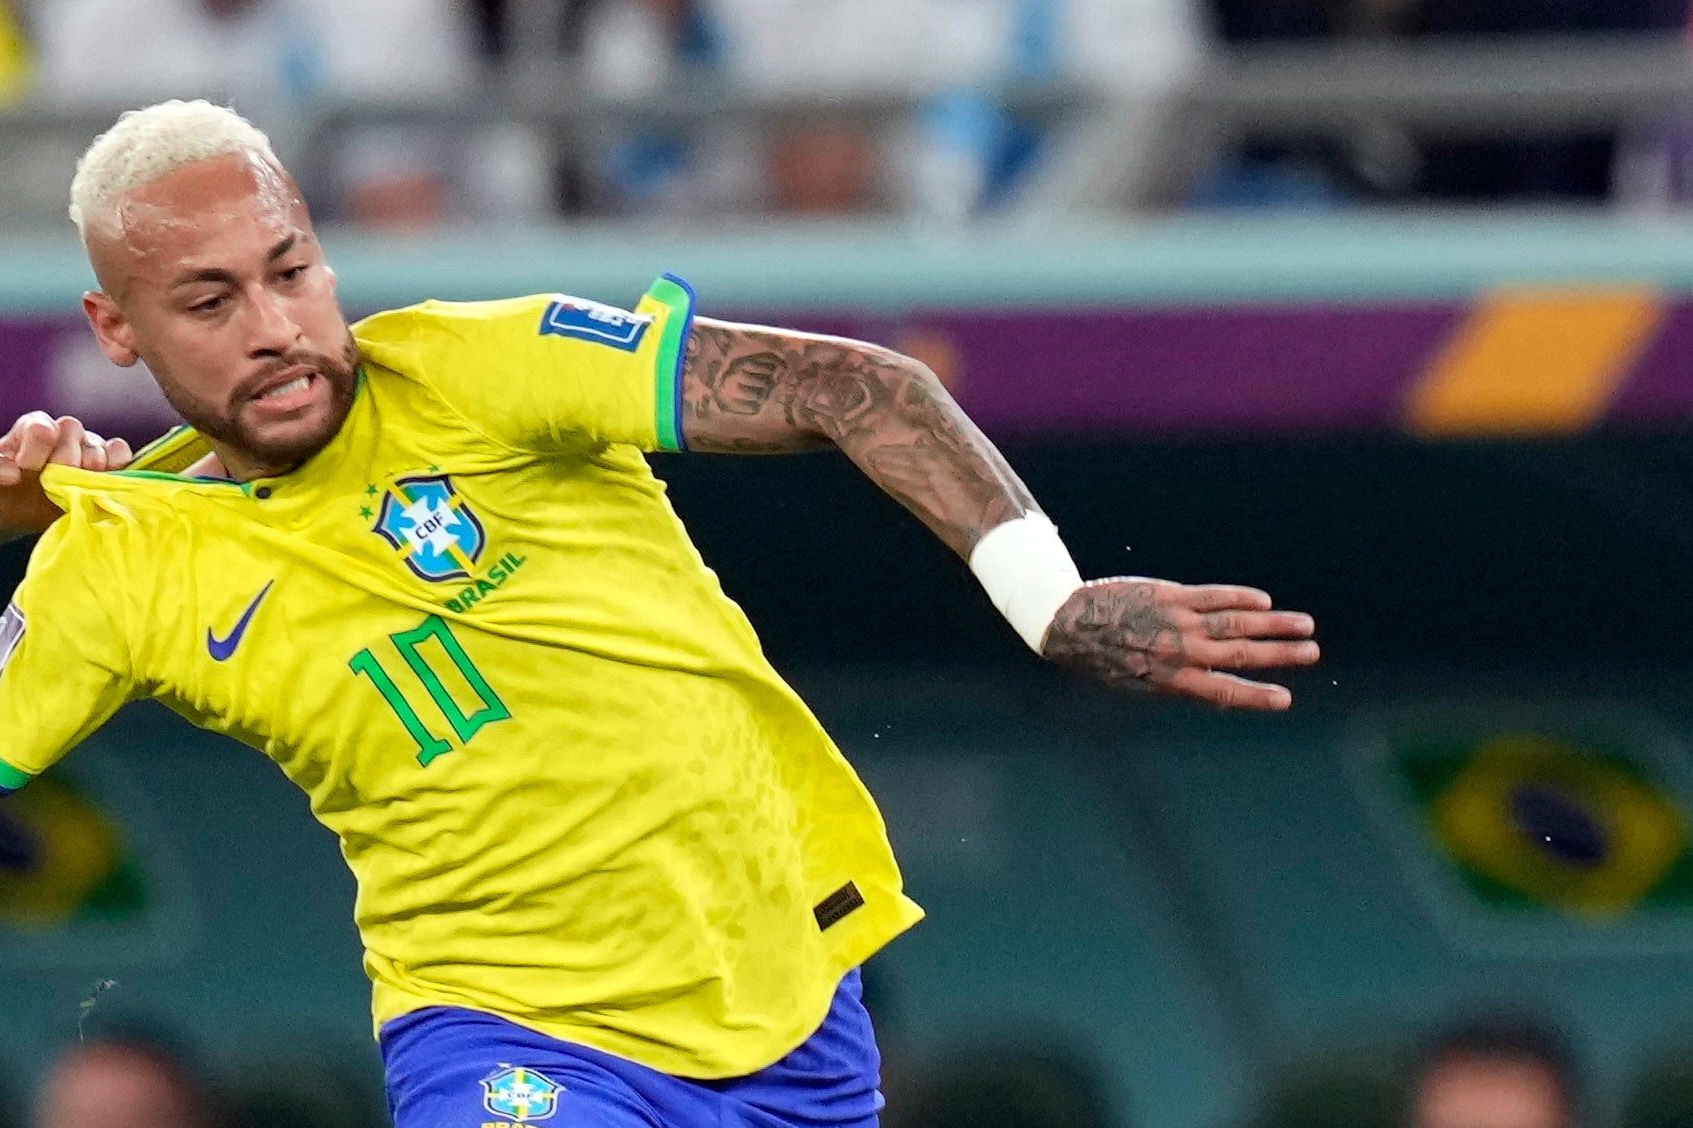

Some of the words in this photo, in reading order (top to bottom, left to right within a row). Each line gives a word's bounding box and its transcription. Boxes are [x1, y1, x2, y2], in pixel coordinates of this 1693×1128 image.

[415, 511, 443, 540] CBF
[443, 552, 527, 614] BRASIL
[348, 614, 512, 768] 10
